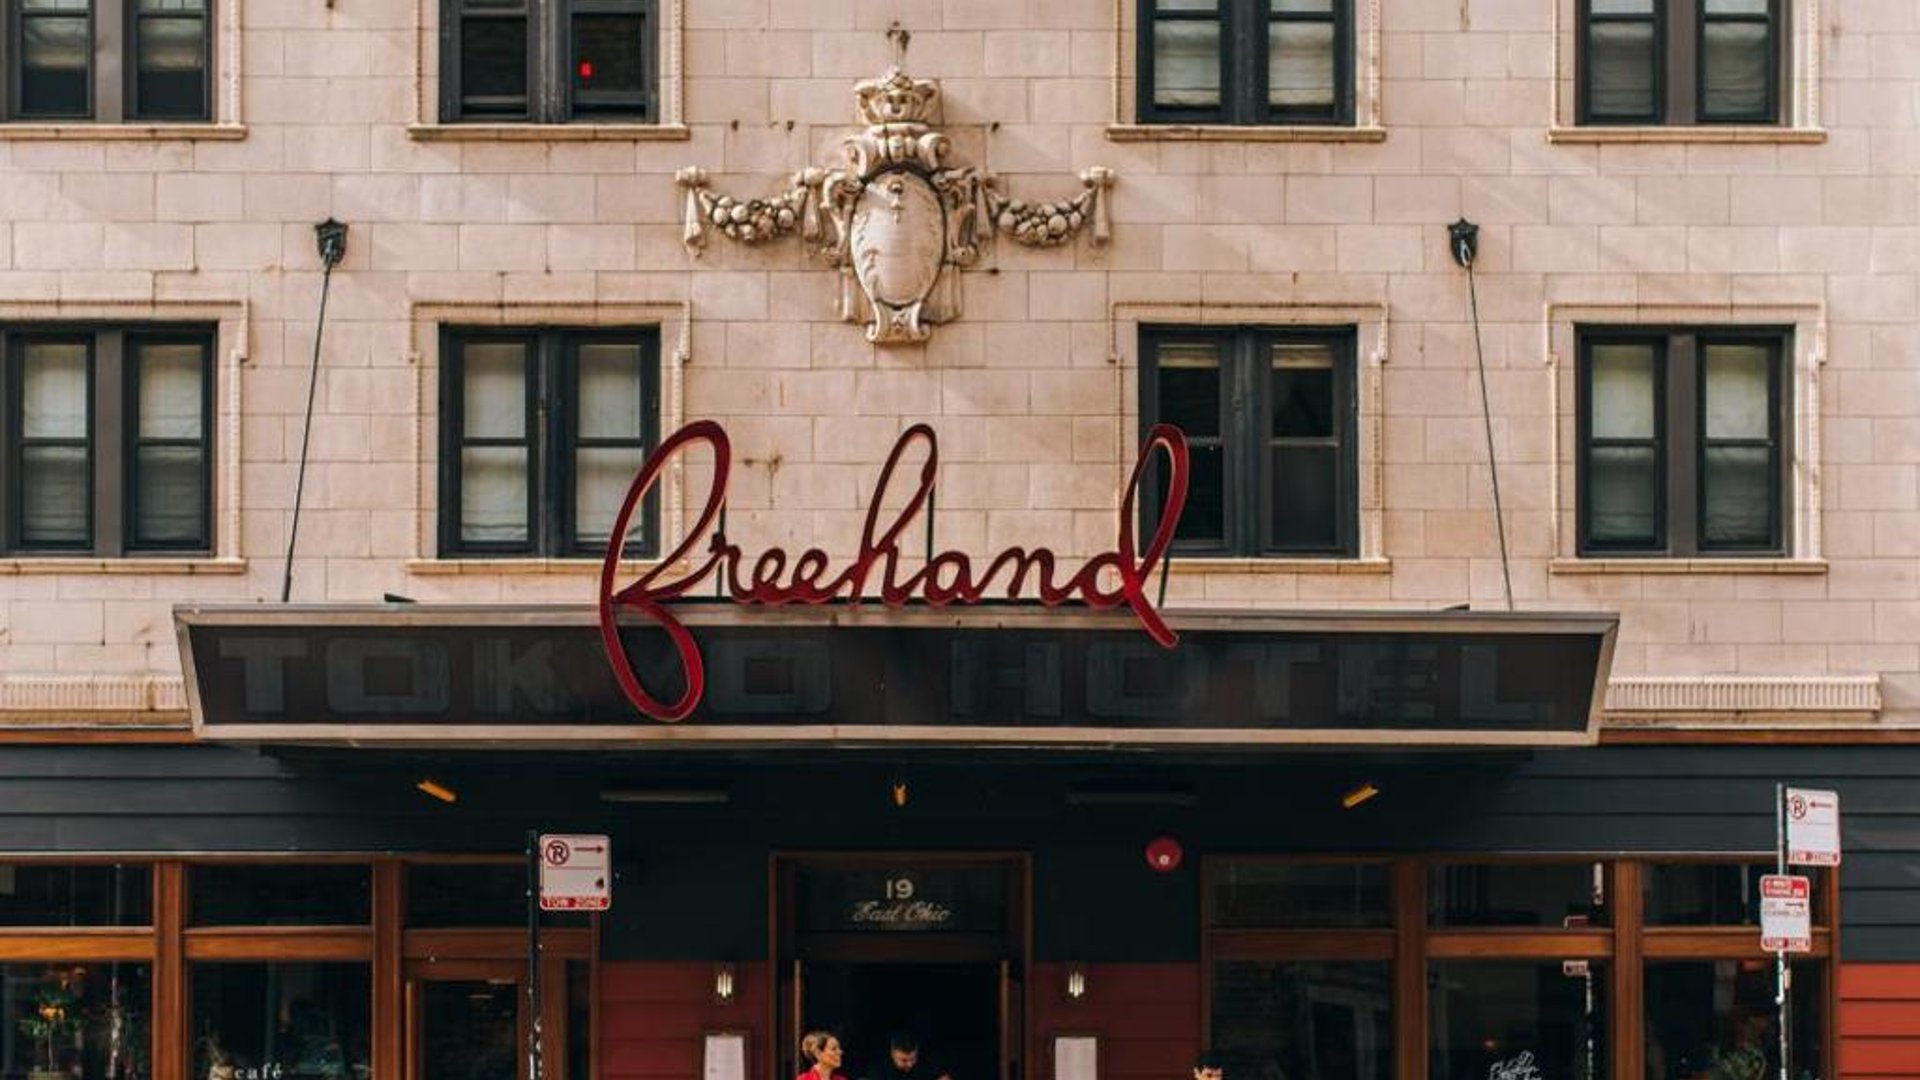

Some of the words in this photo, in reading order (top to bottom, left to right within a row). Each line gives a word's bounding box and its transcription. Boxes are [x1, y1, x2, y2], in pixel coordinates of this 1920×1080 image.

[600, 420, 1188, 721] freehand
[948, 640, 1550, 722] HOTEL
[886, 878, 914, 899] 19
[852, 901, 903, 923] East
[905, 900, 952, 923] Ohio
[234, 1062, 283, 1080] café
